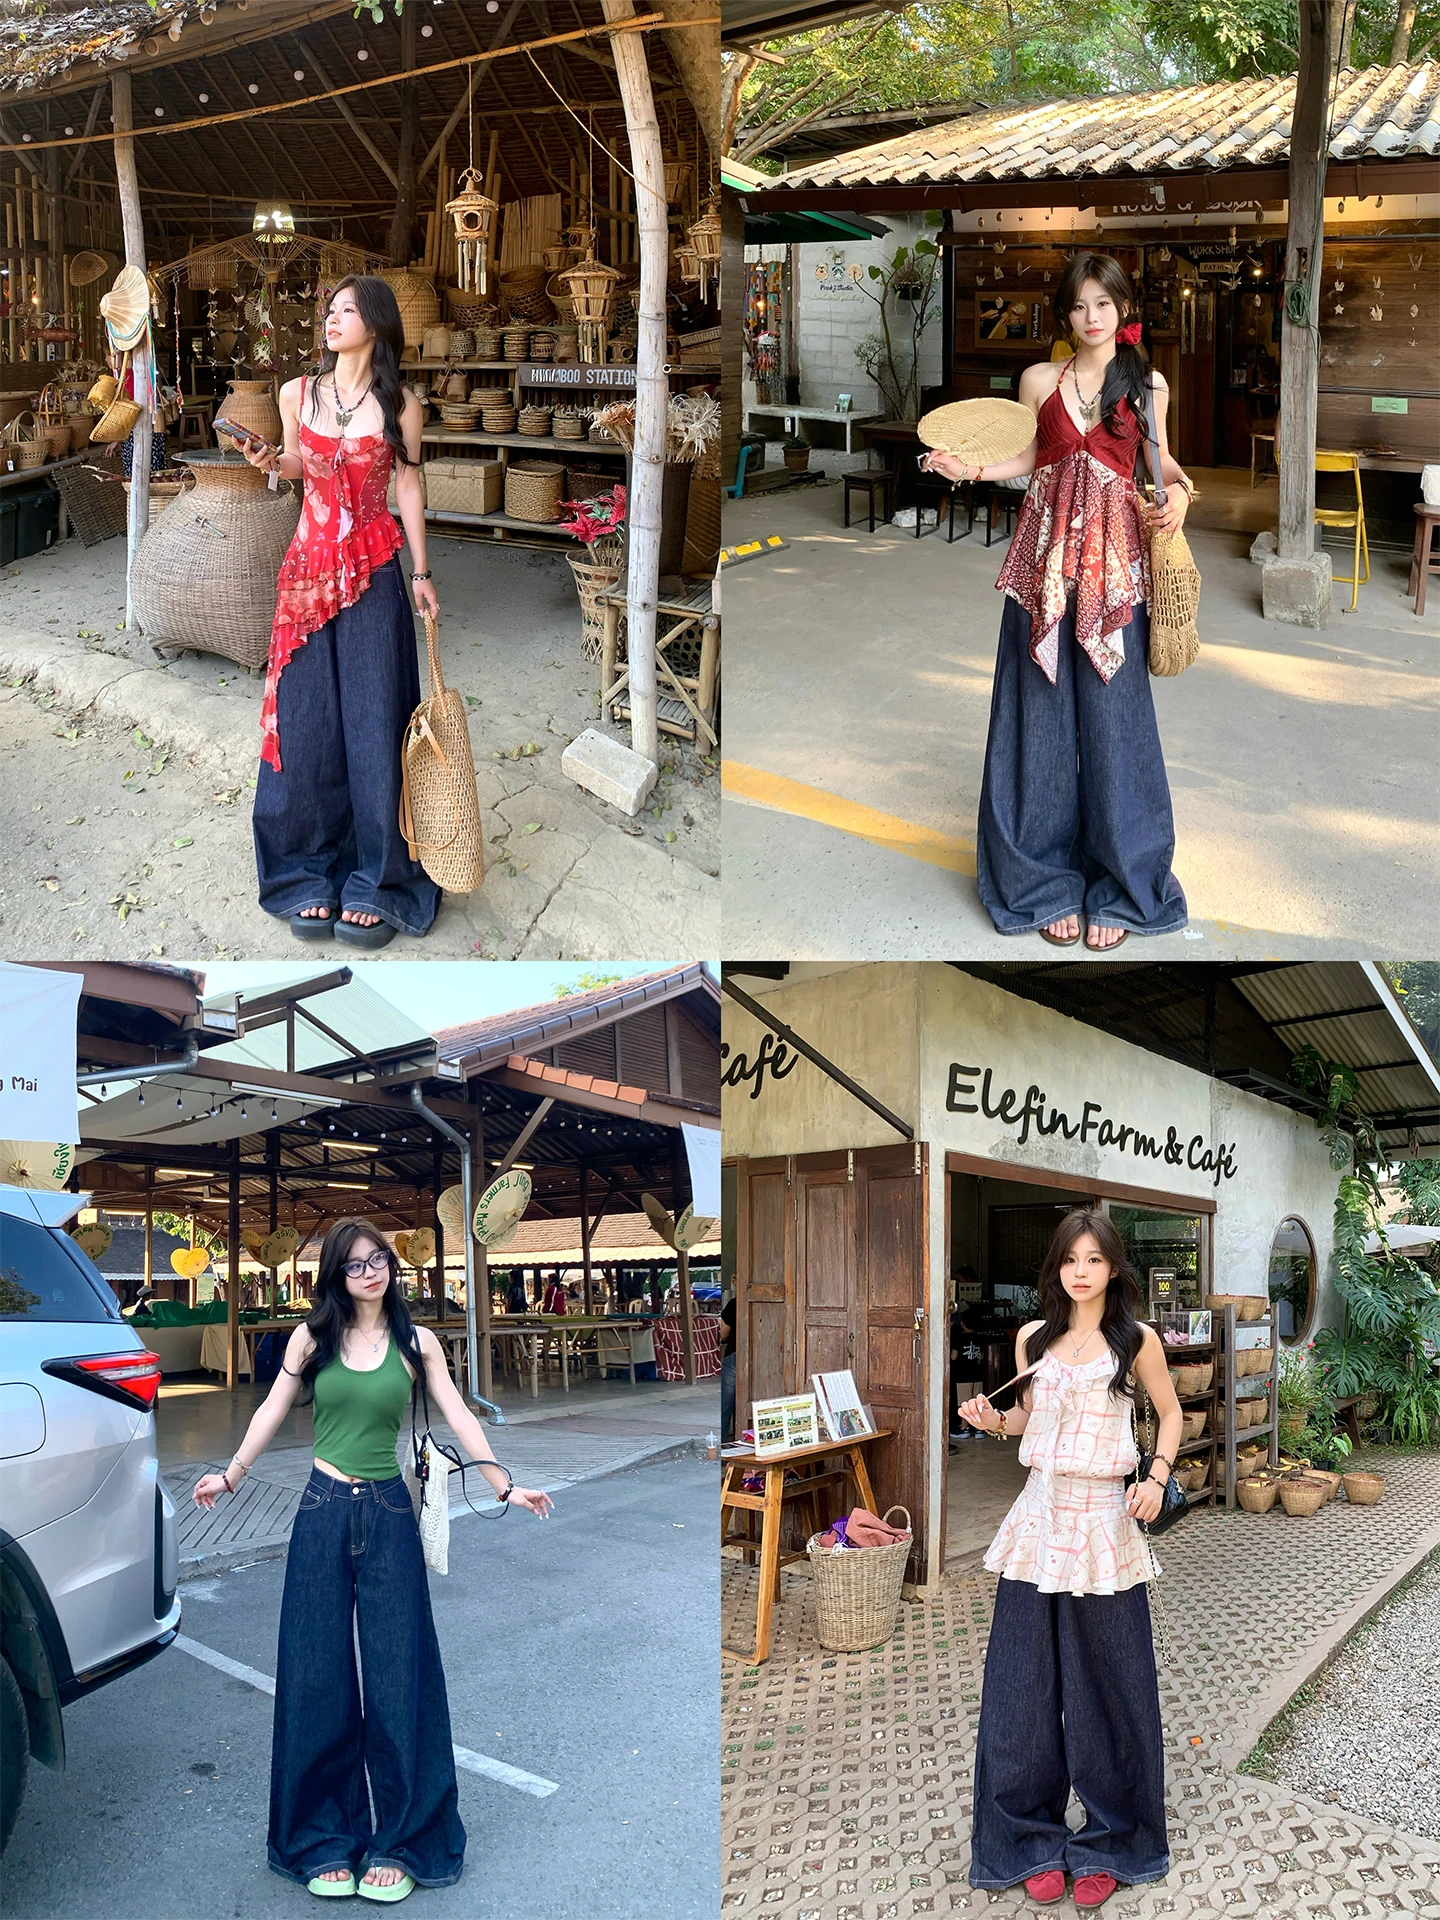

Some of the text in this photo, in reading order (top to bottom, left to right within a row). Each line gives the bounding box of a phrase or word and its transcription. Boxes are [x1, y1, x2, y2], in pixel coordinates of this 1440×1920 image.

[1032, 303, 1040, 338] Workshop
[586, 368, 637, 386] STATION
[11, 1075, 38, 1092] Mai
[946, 1062, 1239, 1187] Elefin Farm & Café
[480, 1176, 510, 1209] Farmers
[475, 1212, 489, 1239] Market
